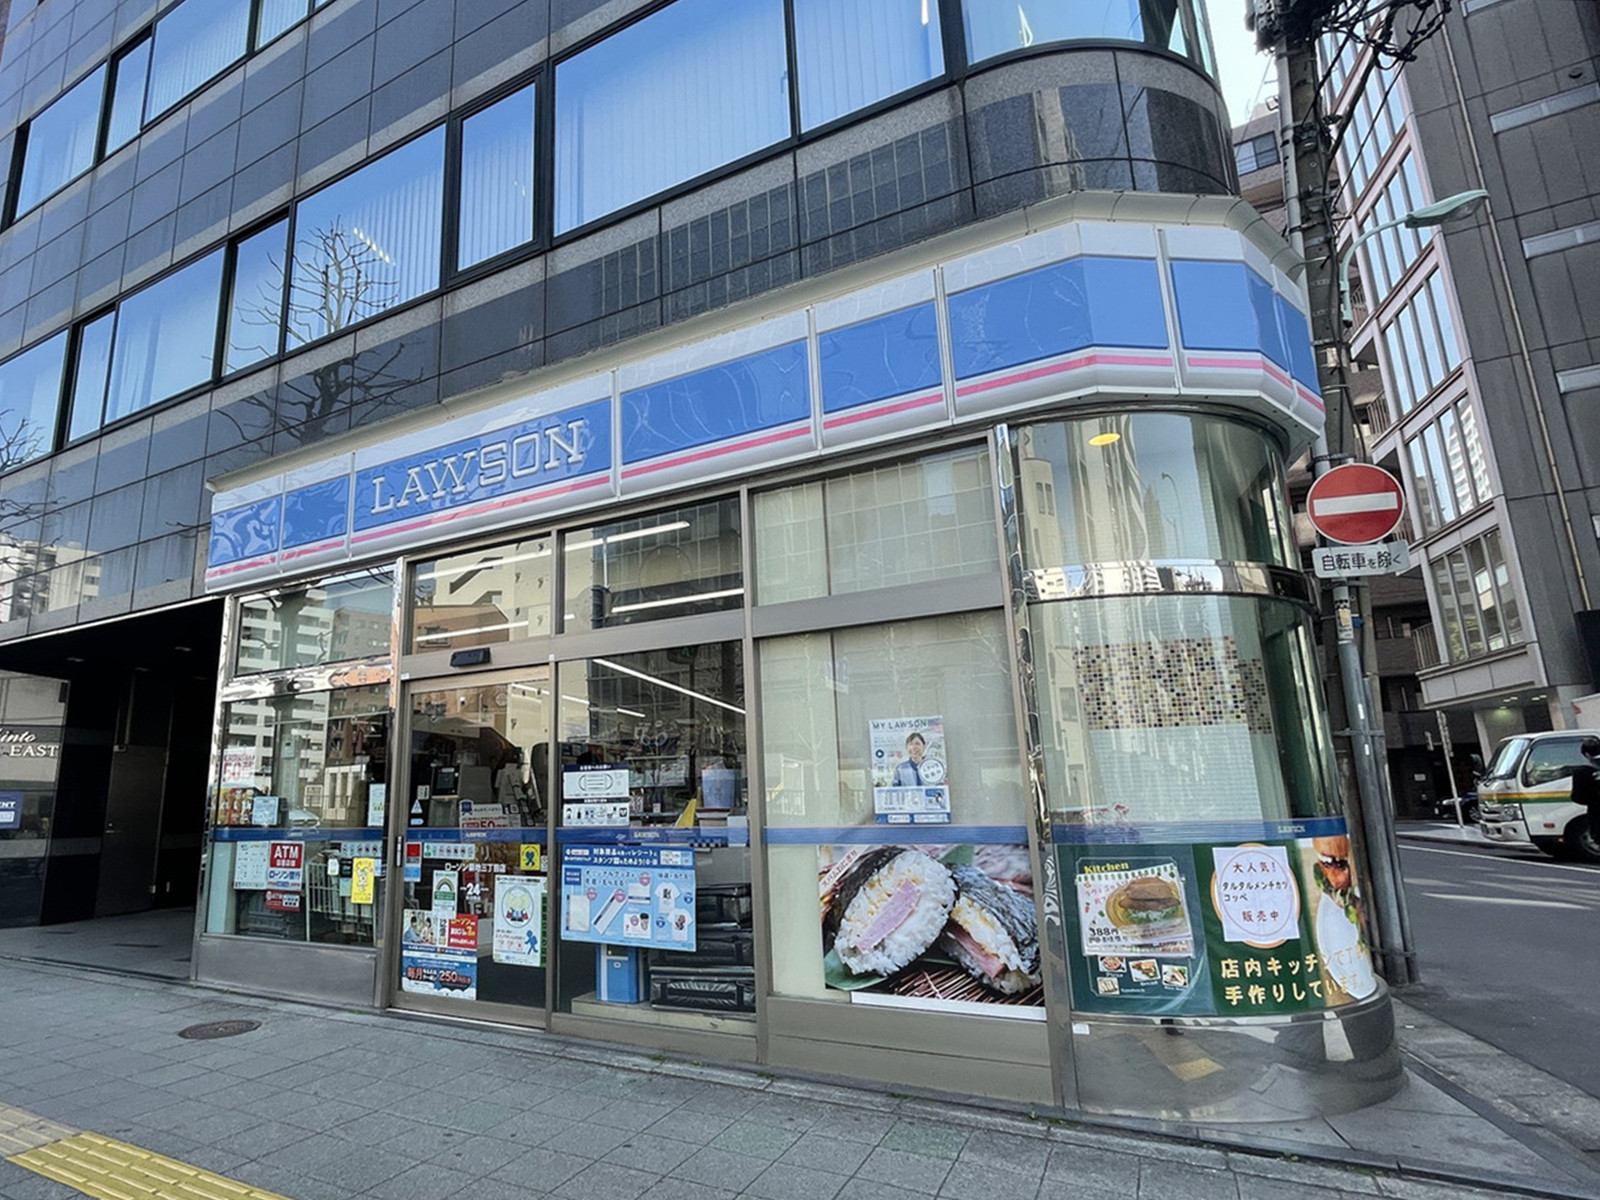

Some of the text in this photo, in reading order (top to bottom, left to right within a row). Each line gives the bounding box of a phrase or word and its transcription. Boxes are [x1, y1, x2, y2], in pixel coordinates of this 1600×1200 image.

[371, 418, 588, 514] LAWSON
[1322, 551, 1401, 571] 自転車を除く
[888, 719, 927, 729] LAWSON
[10, 744, 59, 757] EAST
[274, 846, 299, 859] ATM
[1083, 862, 1130, 875] Kitchen
[1233, 862, 1276, 873] 大人気!
[466, 883, 481, 896] 24
[1222, 881, 1288, 891] タルタルメンチカツ
[1224, 893, 1248, 902] コッペ
[1242, 910, 1279, 922] 販売中
